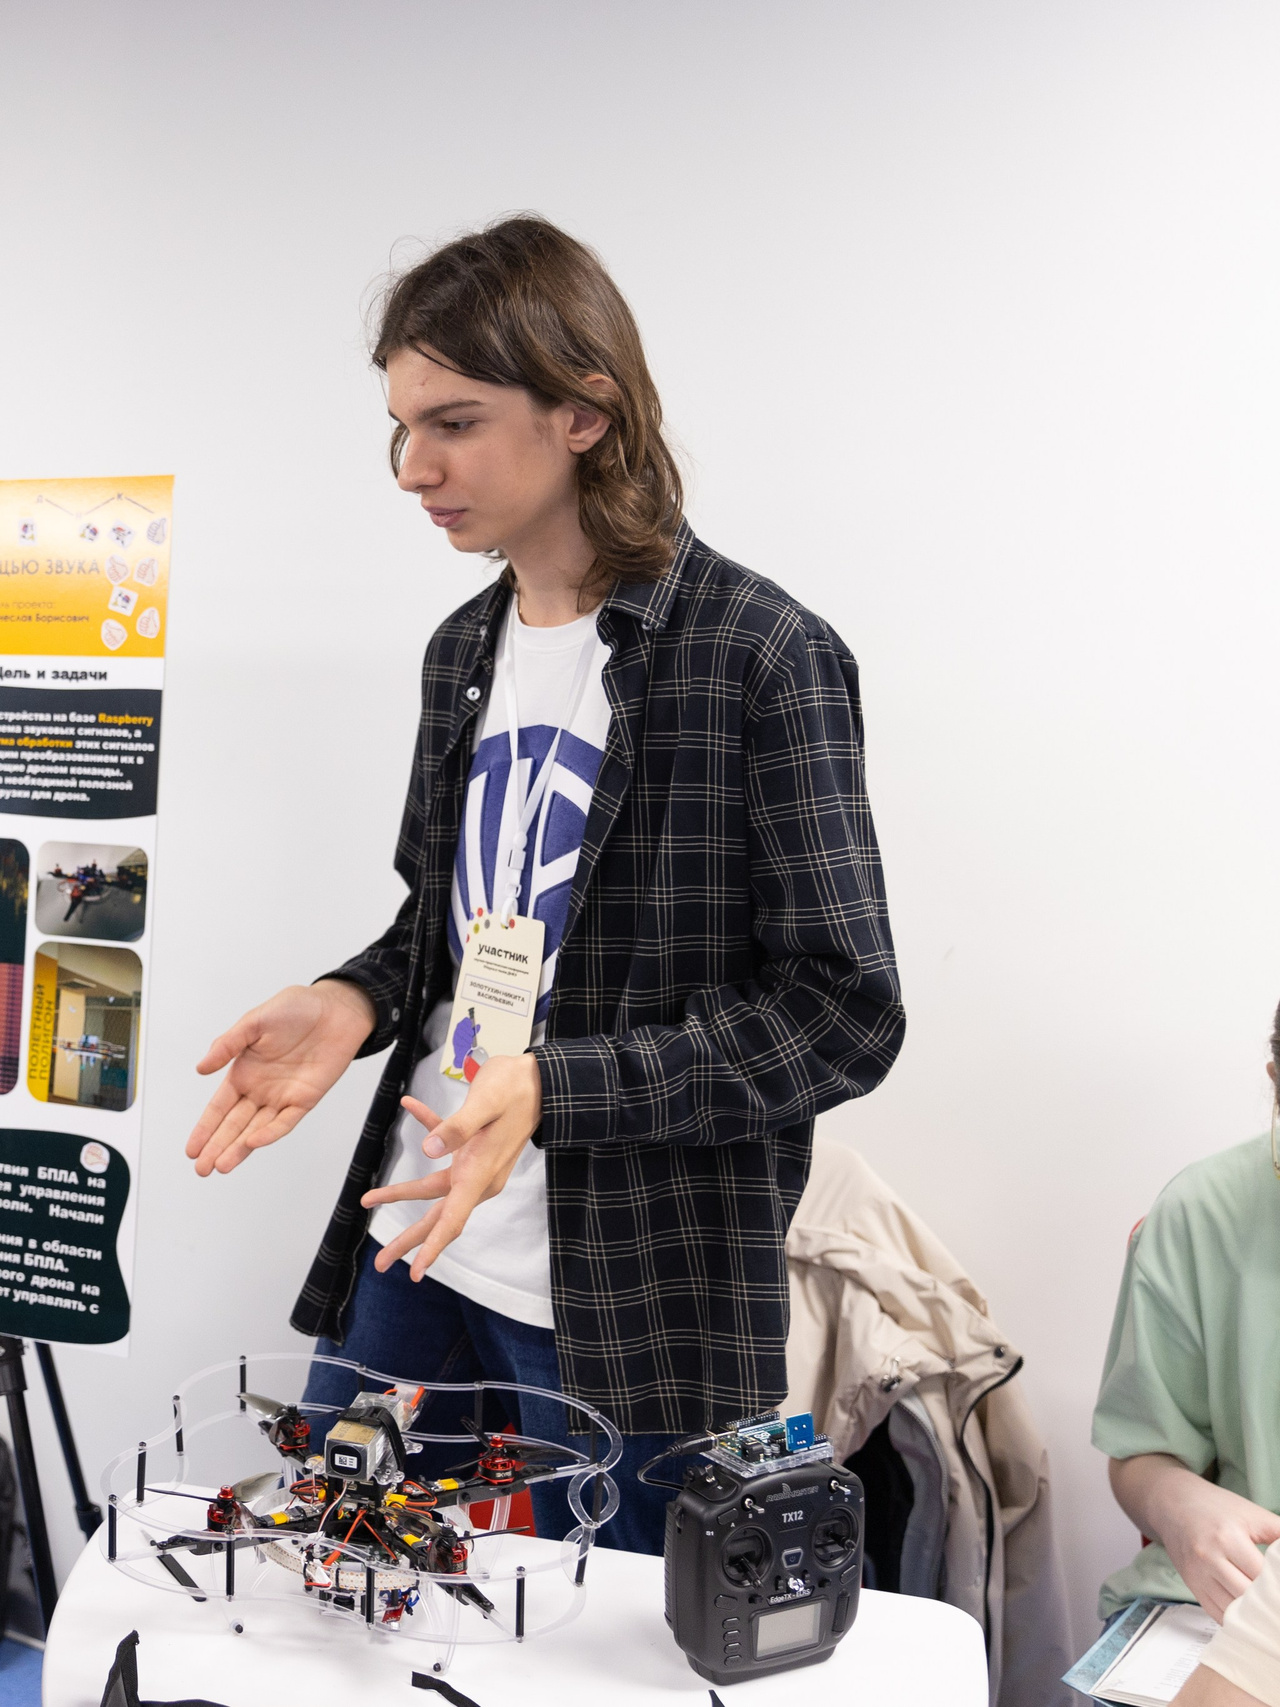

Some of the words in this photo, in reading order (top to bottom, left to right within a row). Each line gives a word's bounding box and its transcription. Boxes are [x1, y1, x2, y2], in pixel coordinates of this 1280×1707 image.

[45, 559, 100, 575] ЗВУКА
[35, 614, 89, 623] Борисович
[37, 669, 45, 679] и
[51, 669, 107, 682] задачи
[53, 713, 67, 722] на
[69, 712, 96, 723] базе
[98, 713, 153, 727] Raspberry
[23, 725, 75, 737] звуковых
[77, 727, 132, 739] сигналов,
[16, 736, 73, 749] обработки
[75, 741, 100, 750] этих
[102, 742, 155, 752] сигналов
[20, 750, 118, 764] преобразованием
[27, 765, 68, 775] дроном
[70, 766, 123, 777] команды.
[4, 775, 77, 789] необходимой
[78, 779, 133, 791] полезной
[31, 790, 51, 800] для
[53, 791, 90, 802] дрона.
[478, 944, 528, 964] участник
[37, 1166, 79, 1184] БПЛА
[87, 1176, 106, 1189] на
[19, 1184, 105, 1207] управления
[48, 1204, 105, 1225] Начали
[28, 1238, 37, 1249] в
[42, 1239, 102, 1260] области
[24, 1253, 70, 1273] БПЛА.
[30, 1274, 75, 1292] дрона
[81, 1283, 100, 1296] на
[12, 1288, 86, 1311] управлять
[89, 1301, 99, 1314] с
[782, 1510, 804, 1523] TX12
[770, 1594, 792, 1602] EdgeTX
